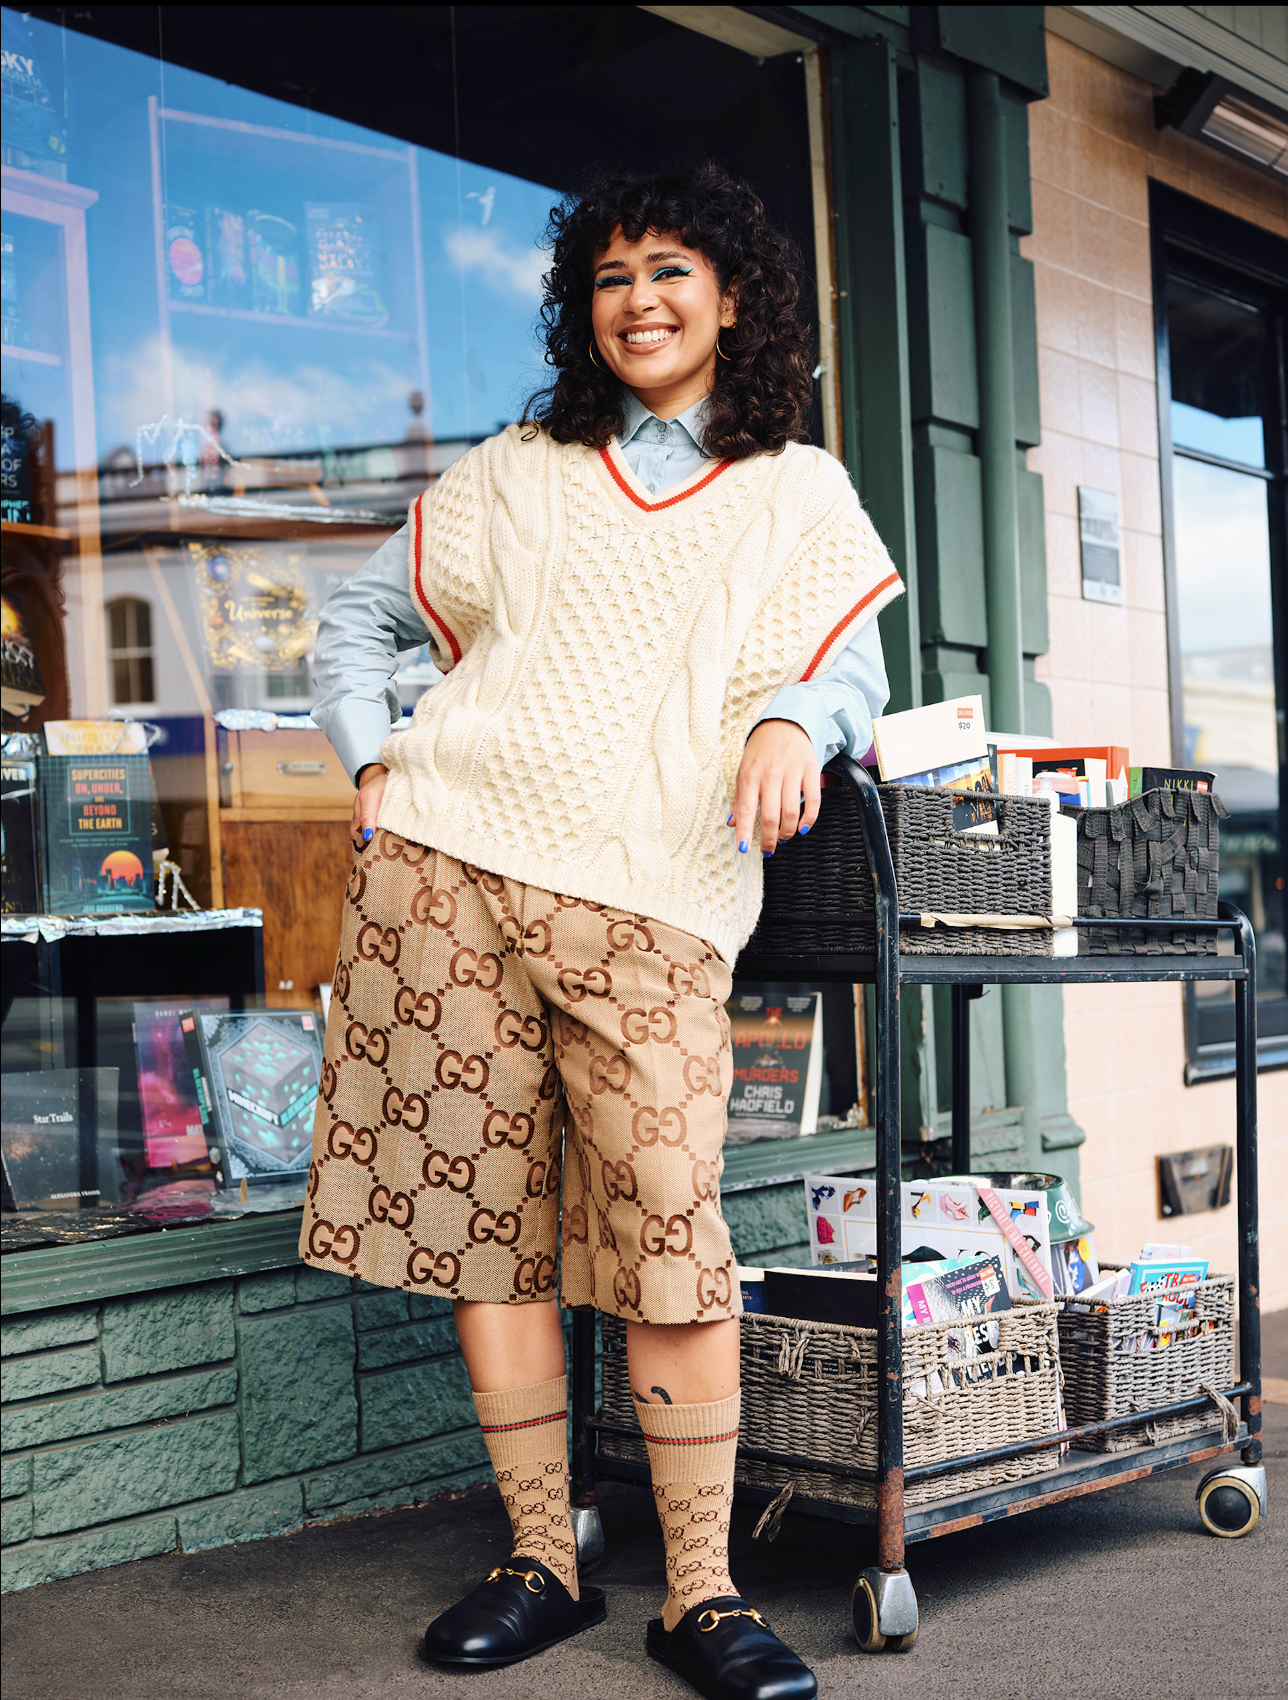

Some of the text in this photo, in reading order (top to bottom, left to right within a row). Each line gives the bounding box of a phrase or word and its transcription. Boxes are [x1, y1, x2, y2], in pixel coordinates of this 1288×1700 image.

[224, 599, 294, 622] Universe
[958, 721, 971, 731] $20
[71, 768, 126, 781] SUPERCITIES
[75, 783, 123, 795] ON, UNDER,
[1164, 778, 1194, 791] NIKKI
[83, 804, 117, 816] BEYOND
[78, 818, 122, 830] THE EARTH
[734, 1031, 807, 1050] APOLLO
[733, 1067, 799, 1084] MURDERS
[744, 1085, 783, 1099] CHRIS
[730, 1098, 795, 1114] HADFIELD
[33, 1111, 74, 1124] Star Trails
[1019, 1246, 1049, 1285] CALENDAR
[917, 1300, 928, 1314] MY
[961, 1297, 982, 1318] MY
